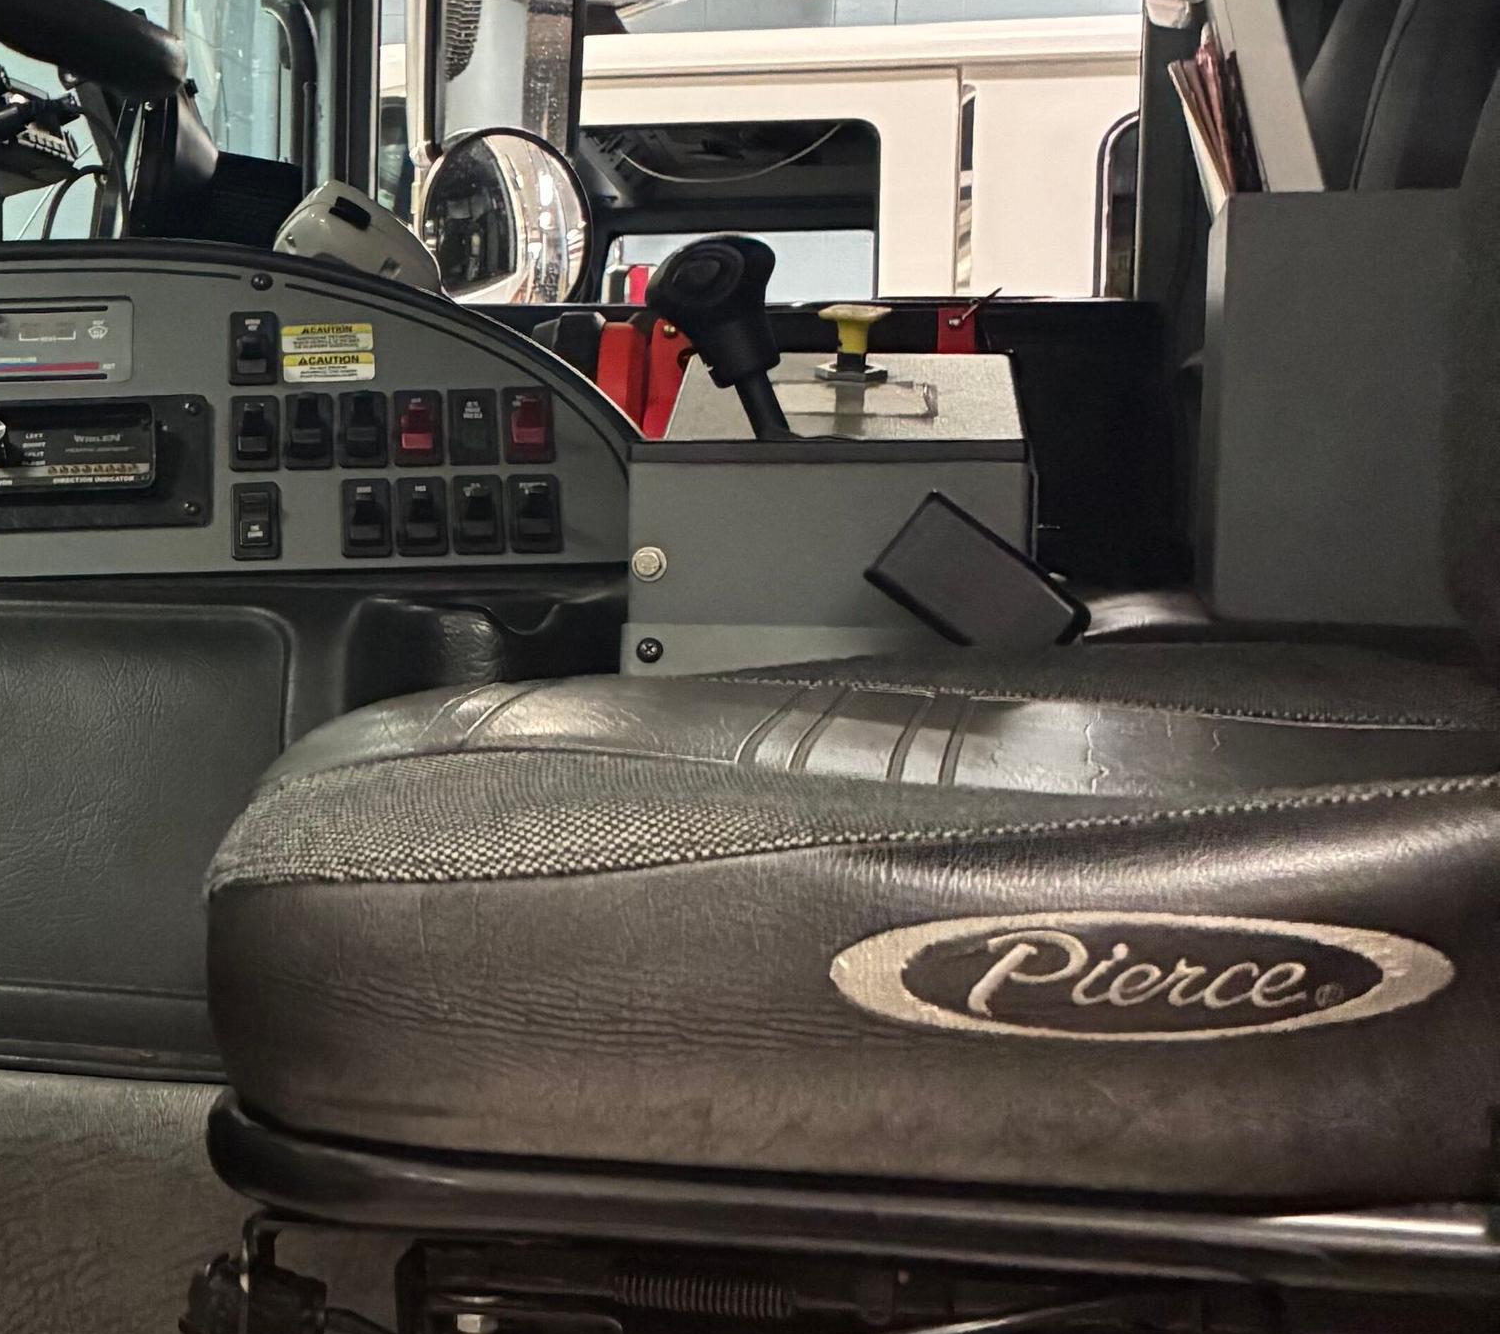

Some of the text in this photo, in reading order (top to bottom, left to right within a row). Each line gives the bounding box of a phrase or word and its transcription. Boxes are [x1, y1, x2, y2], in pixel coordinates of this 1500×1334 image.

[308, 324, 353, 334] CAUTION
[307, 355, 360, 366] CAUTION
[94, 474, 135, 483] INDICATOR
[967, 929, 1310, 1018] Pierce
